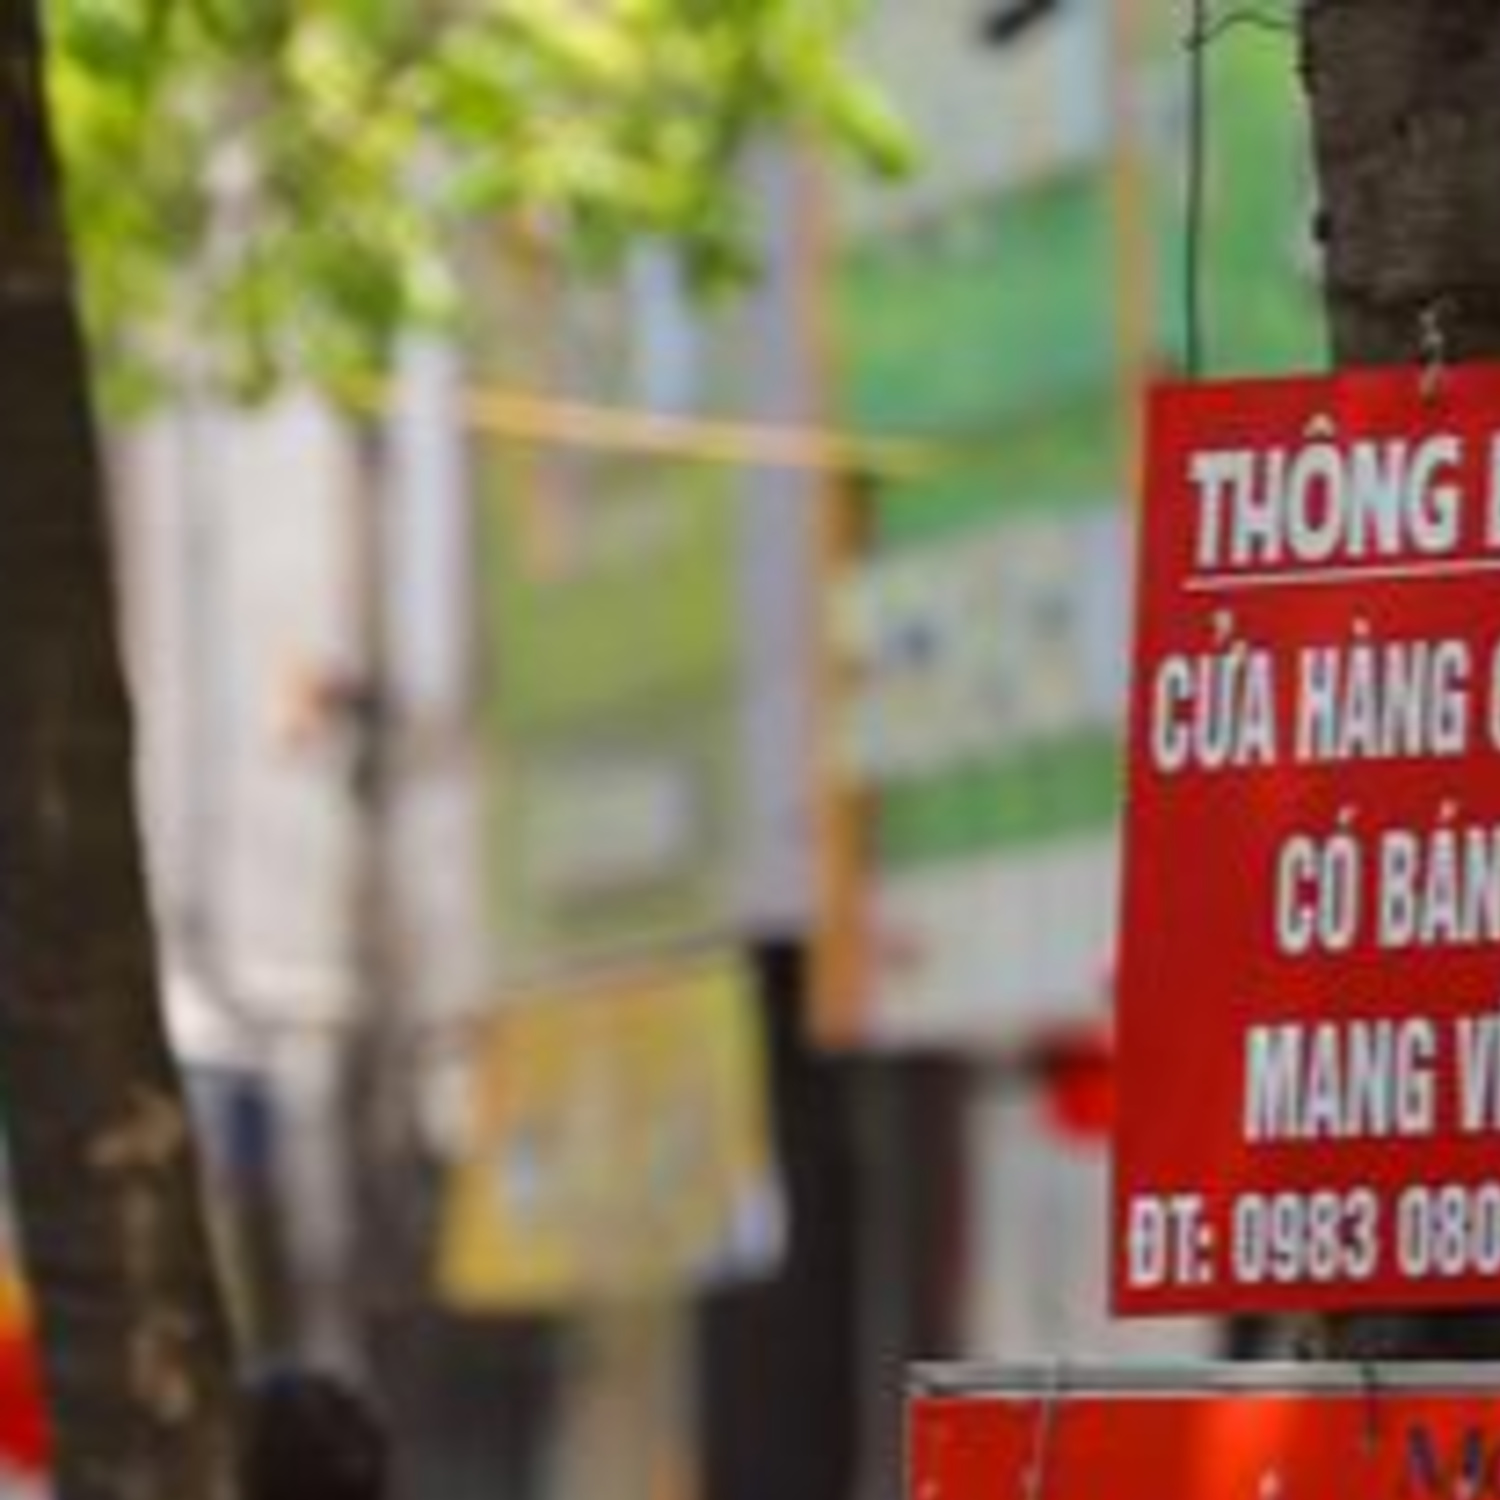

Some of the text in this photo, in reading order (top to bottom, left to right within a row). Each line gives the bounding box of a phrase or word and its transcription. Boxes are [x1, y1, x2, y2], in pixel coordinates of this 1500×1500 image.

[1188, 415, 1463, 567] THÔNG
[1150, 610, 1277, 772] CỬA
[1294, 618, 1471, 762] HÀNG
[1275, 806, 1360, 955] CÓ
[1243, 1017, 1437, 1141] MANG
[1127, 1193, 1214, 1288] ĐT:
[1231, 1187, 1379, 1283] 0983
